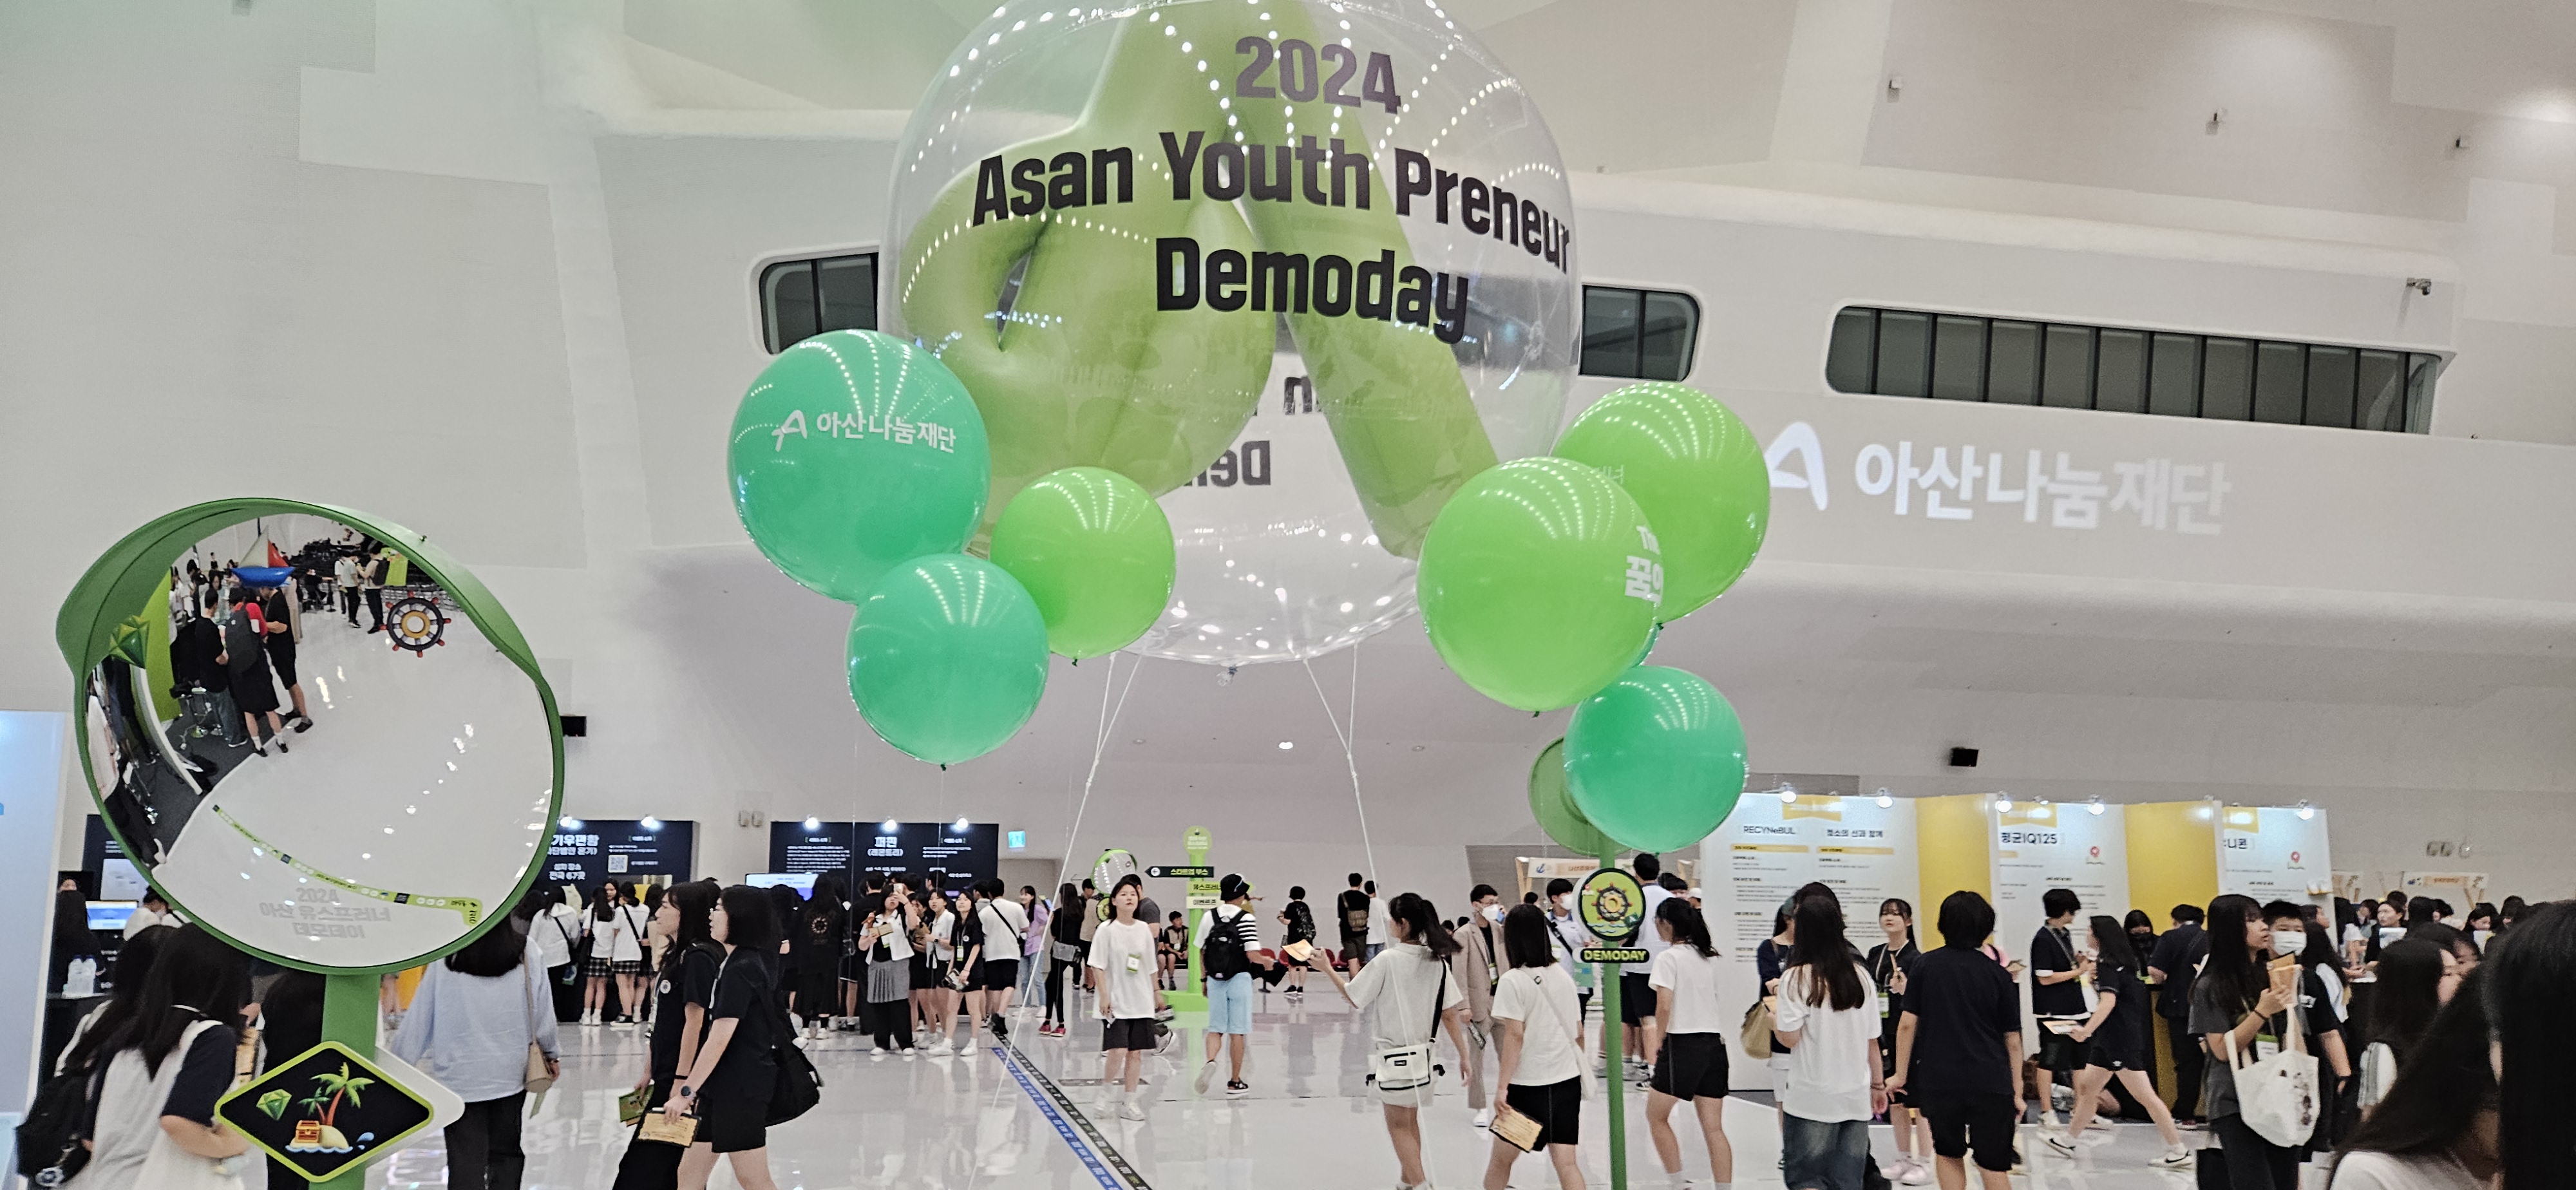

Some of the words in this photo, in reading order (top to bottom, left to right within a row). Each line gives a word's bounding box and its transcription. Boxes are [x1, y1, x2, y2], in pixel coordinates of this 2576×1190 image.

[1235, 36, 1401, 114] 2024
[972, 144, 1133, 227] Asan
[1159, 131, 1373, 211] Youth
[1394, 147, 1570, 274] Preneur
[1155, 236, 1469, 345] Demoday
[817, 411, 957, 453] 아산나눔재단
[1855, 440, 2232, 536] 아산나눔재단
[2001, 832, 2058, 844] 평균IQ125
[259, 902, 294, 918] 아산
[298, 905, 392, 921] 유스프러너
[296, 887, 340, 903] 2024
[1584, 950, 1646, 961] DEMODAY
